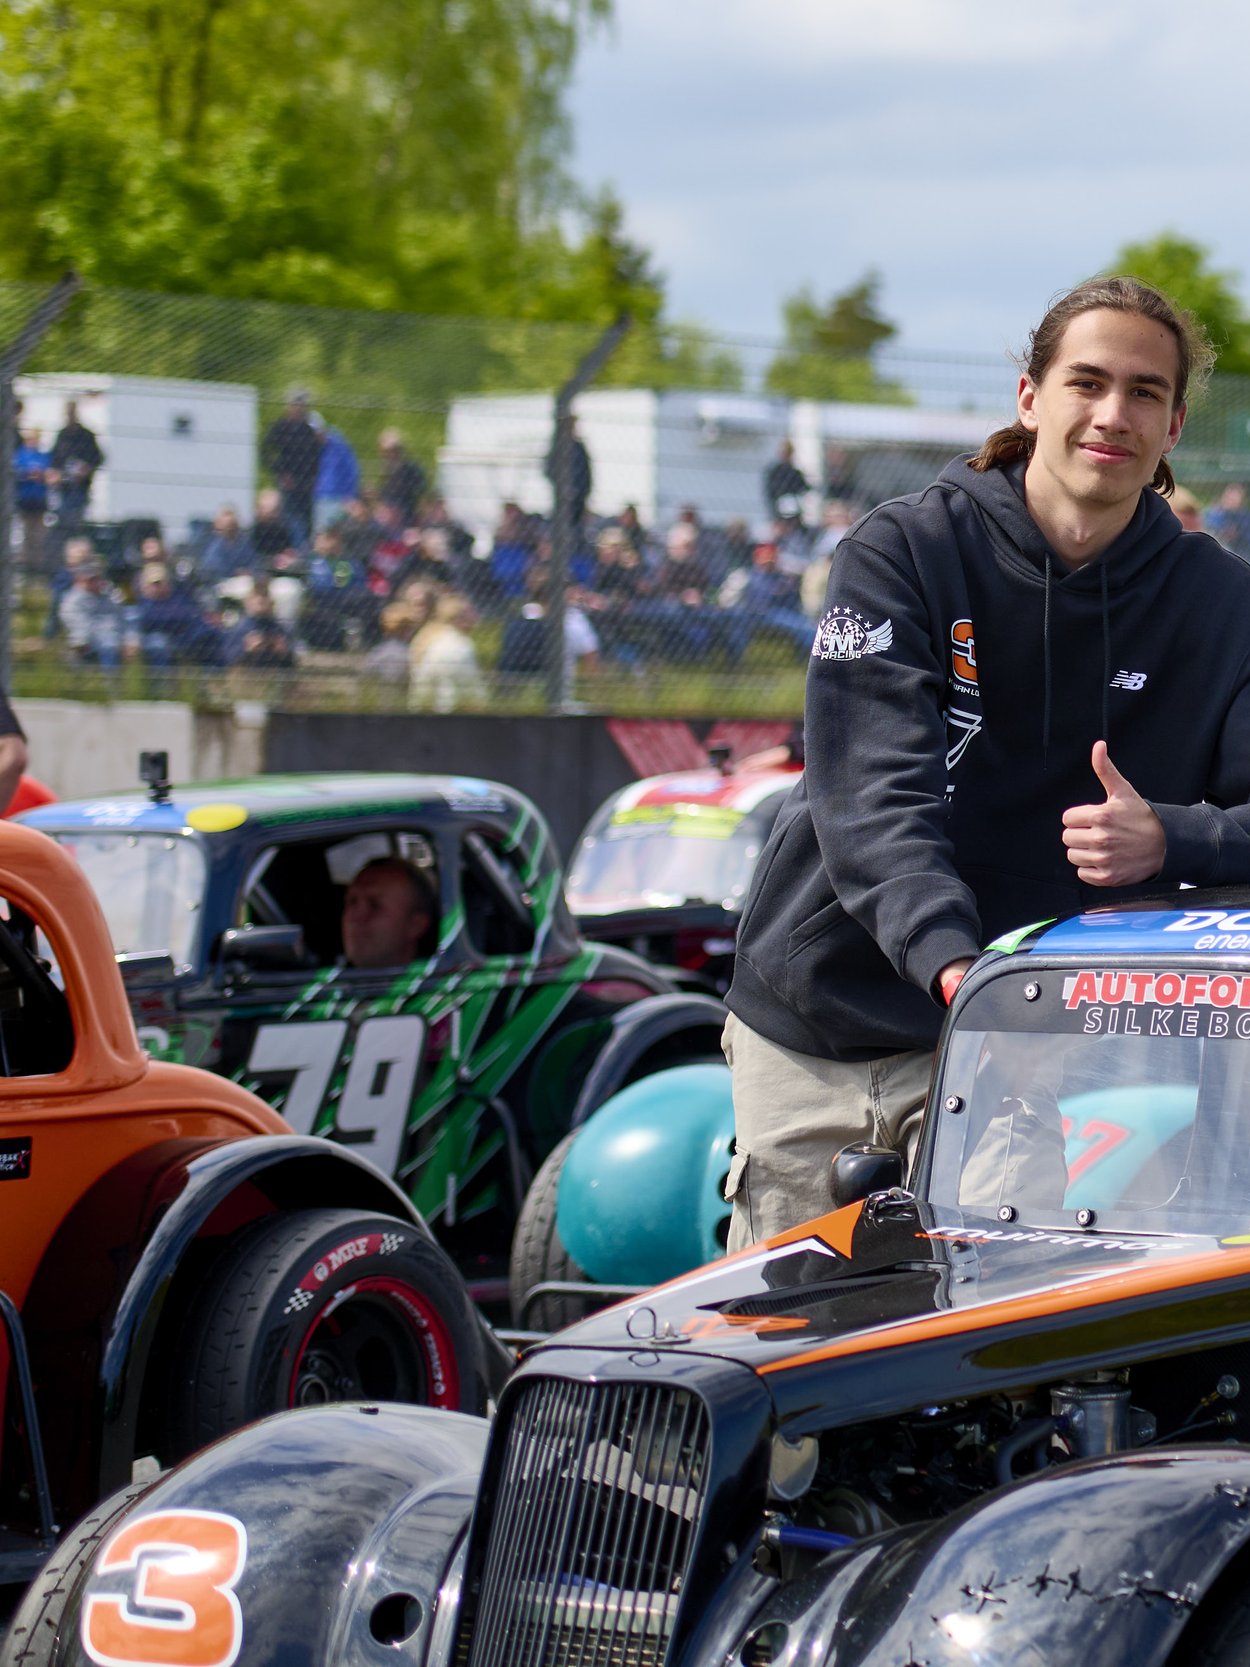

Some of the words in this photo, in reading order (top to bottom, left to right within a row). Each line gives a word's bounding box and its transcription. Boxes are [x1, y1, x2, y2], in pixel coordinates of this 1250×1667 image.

[820, 650, 862, 661] RACING
[247, 1014, 425, 1179] 79
[328, 1237, 370, 1272] MRF
[82, 1508, 247, 1667] 3
